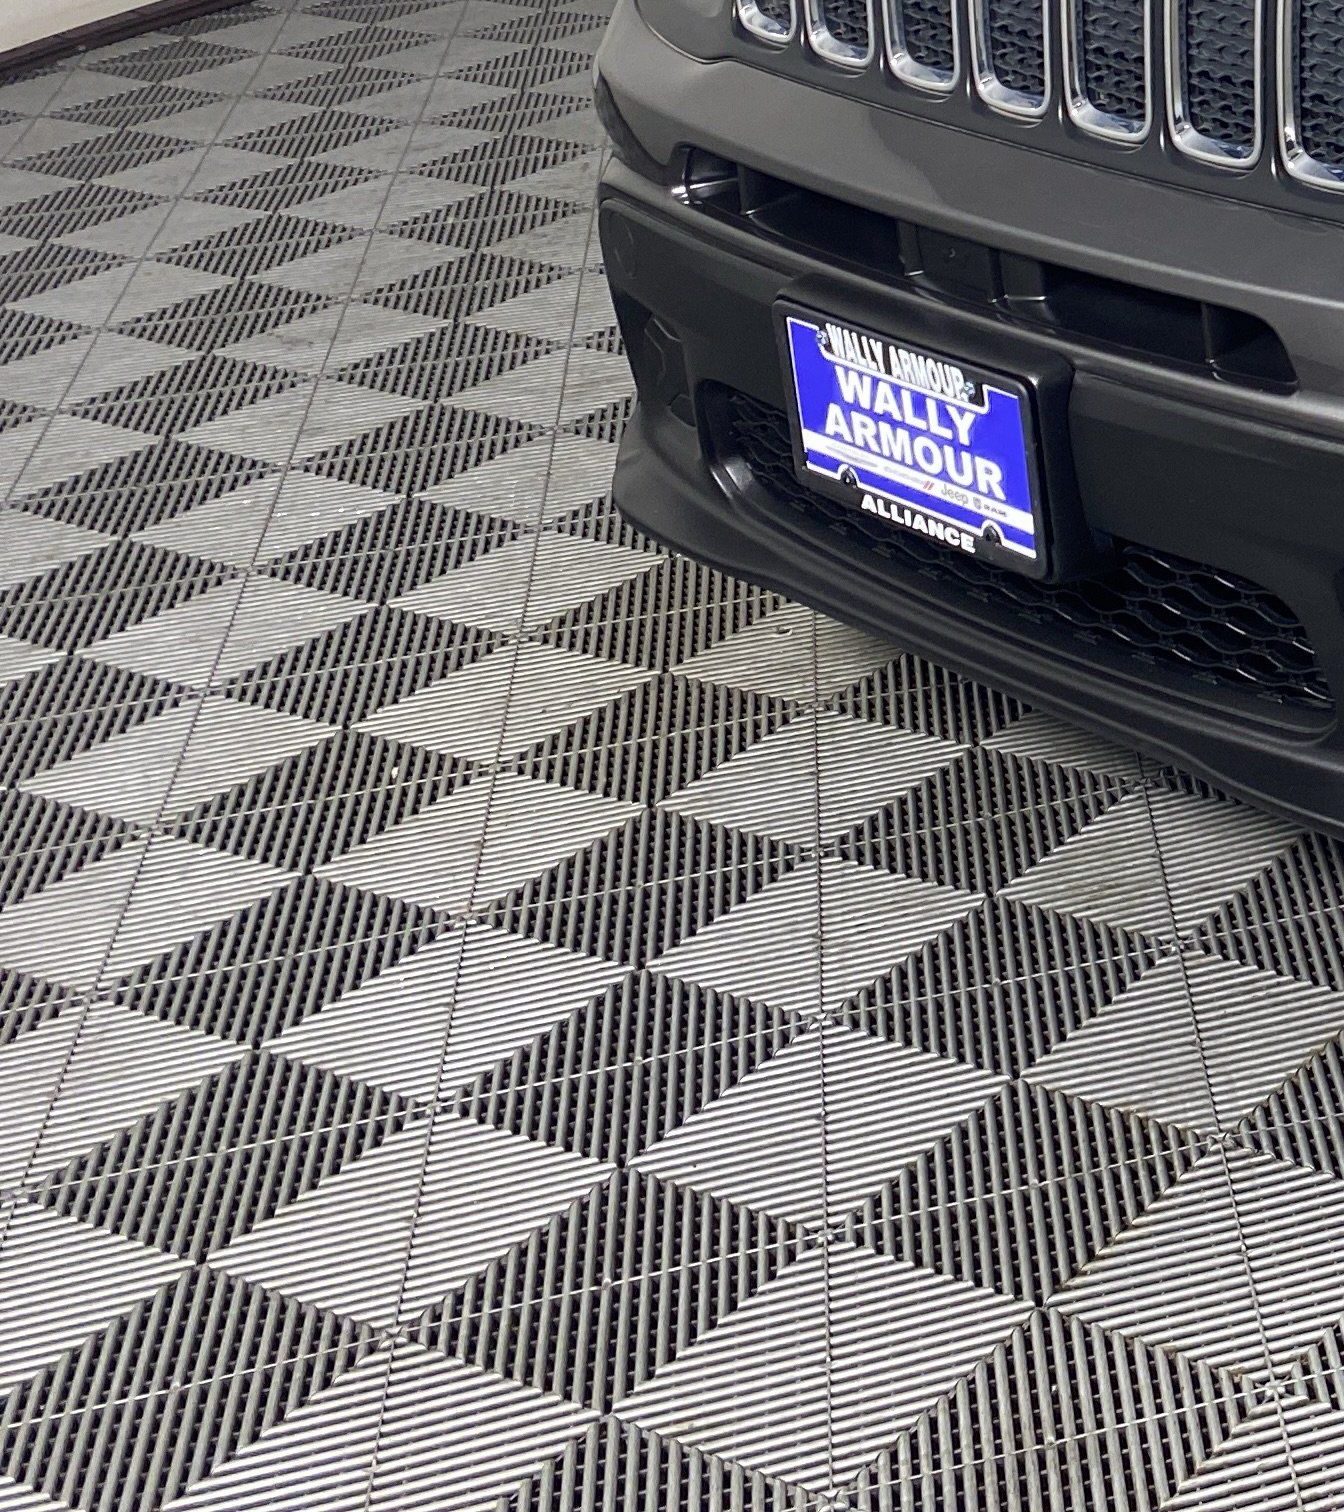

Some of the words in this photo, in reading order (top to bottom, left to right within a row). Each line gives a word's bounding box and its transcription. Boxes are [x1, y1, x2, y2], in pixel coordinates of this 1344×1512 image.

[826, 323, 885, 373] WALLY
[888, 344, 969, 403] ARMOUR
[834, 366, 976, 446] WALLY
[824, 403, 1007, 501] ARMOUR
[861, 494, 976, 554] ALLIANCE
[940, 483, 969, 507] Jeep
